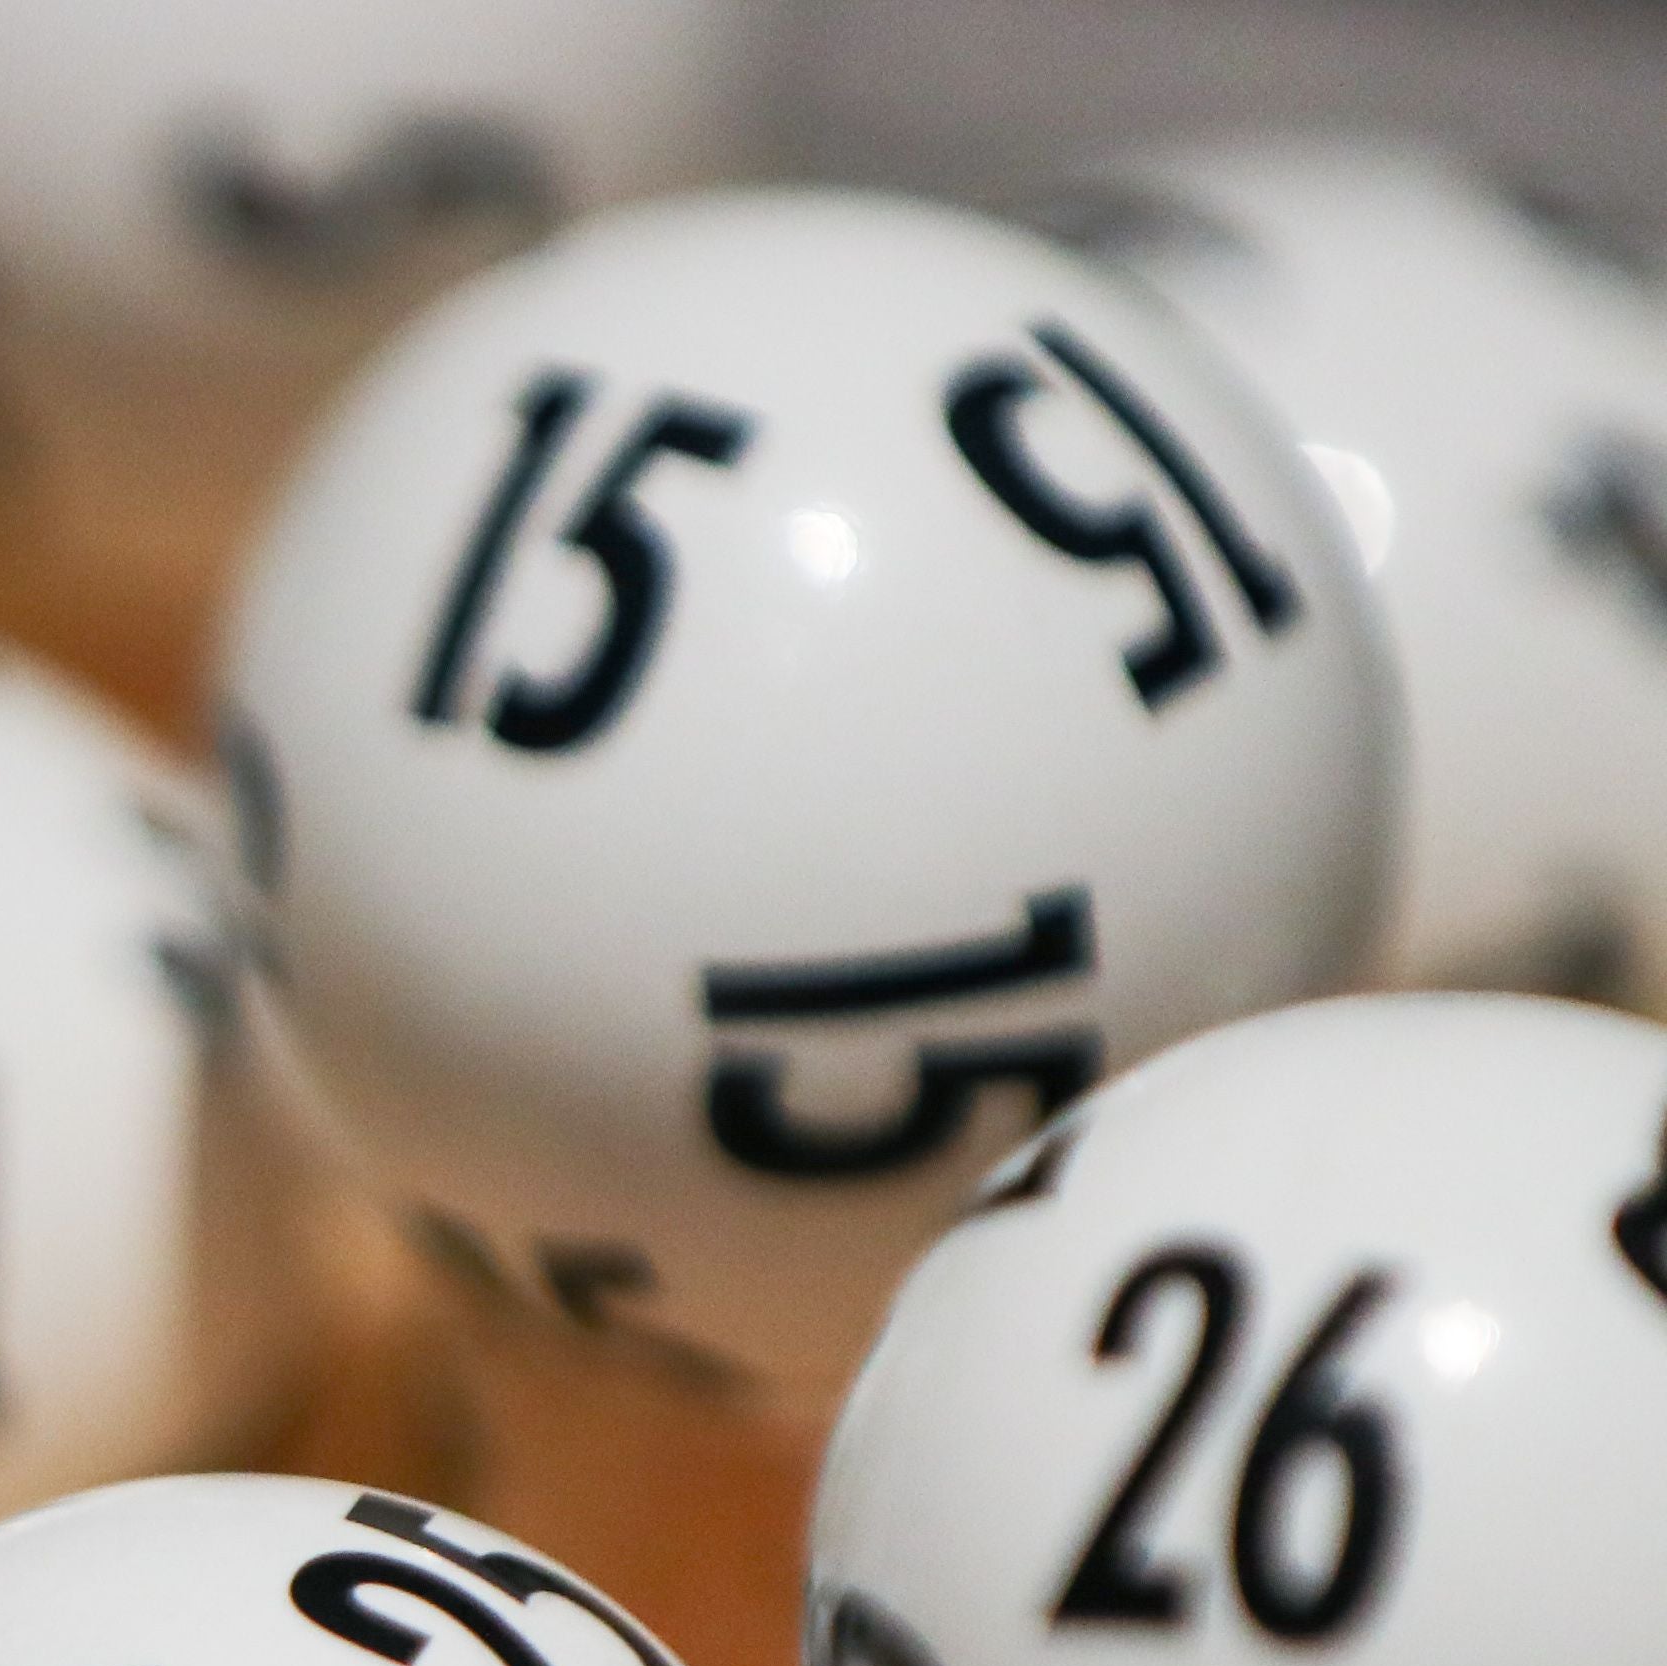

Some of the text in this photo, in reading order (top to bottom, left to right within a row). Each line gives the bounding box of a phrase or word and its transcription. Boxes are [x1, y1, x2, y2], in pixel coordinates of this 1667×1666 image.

[407, 355, 762, 755] 15
[935, 312, 1307, 715] 15
[697, 880, 1107, 1180] 15
[1037, 1230, 1412, 1650] 26
